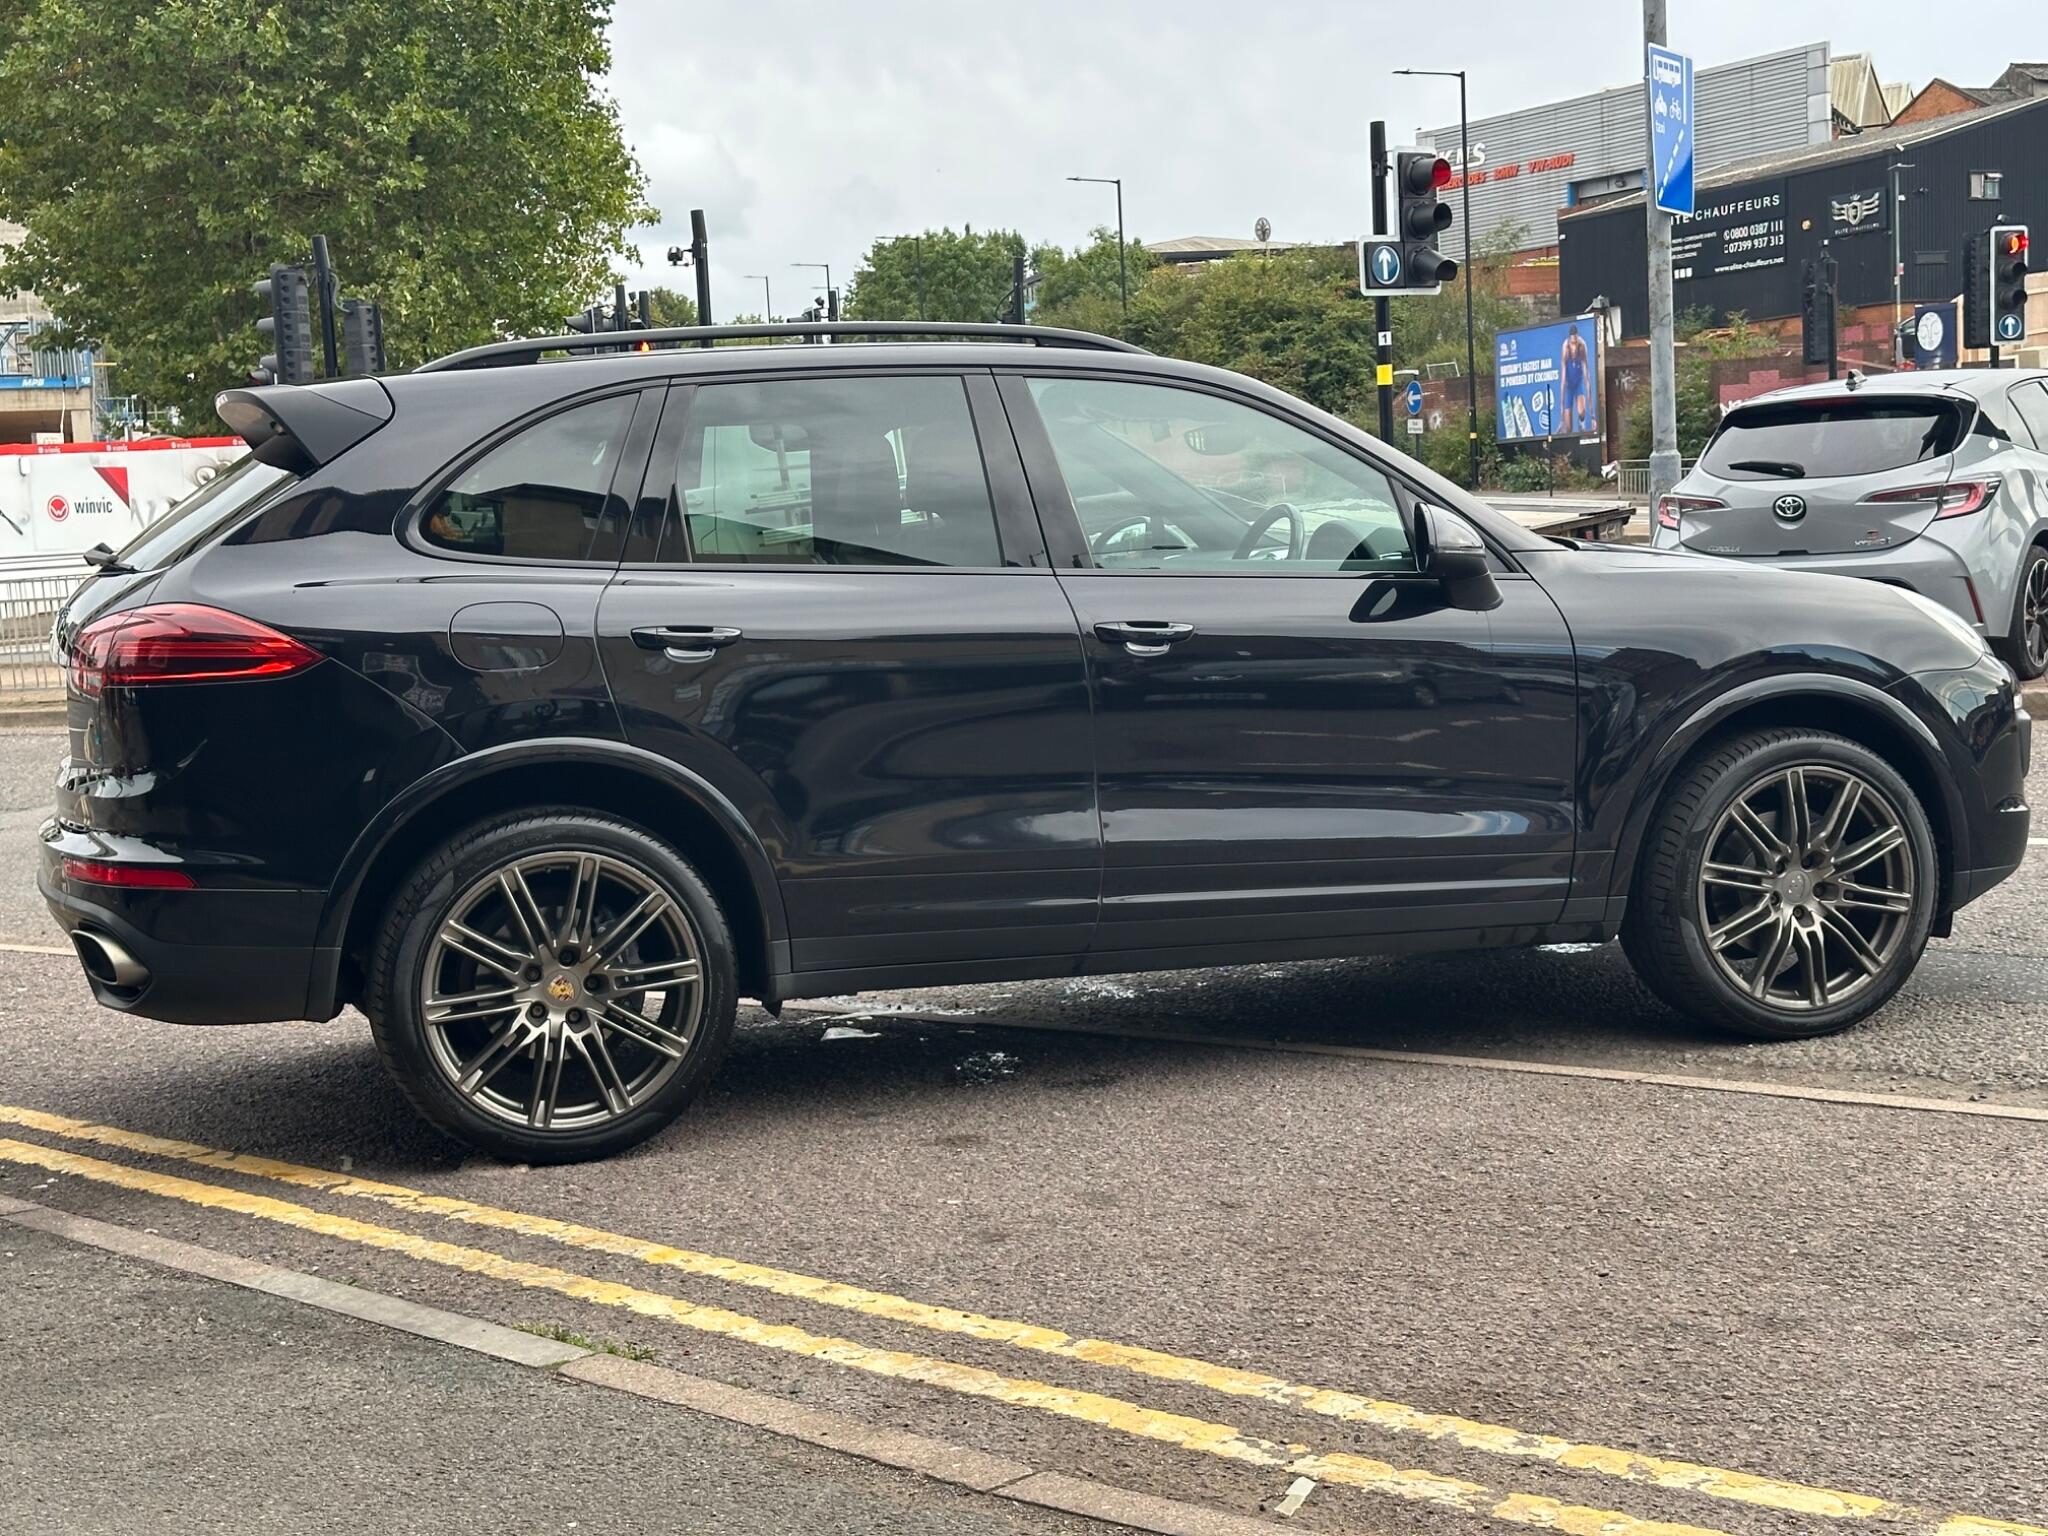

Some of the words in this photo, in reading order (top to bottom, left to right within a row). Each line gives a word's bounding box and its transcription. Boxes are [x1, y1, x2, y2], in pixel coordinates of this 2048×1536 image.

[1494, 162, 1518, 180] BMW
[1695, 194, 1780, 221] CHAUFFEURS
[1730, 227, 1749, 239] 0800
[1749, 222, 1768, 236] 0387
[1770, 220, 1783, 233] 111
[1728, 239, 1752, 253] 07399
[1753, 237, 1768, 249] 937
[1769, 234, 1784, 247] 313
[74, 496, 113, 515] winvic
